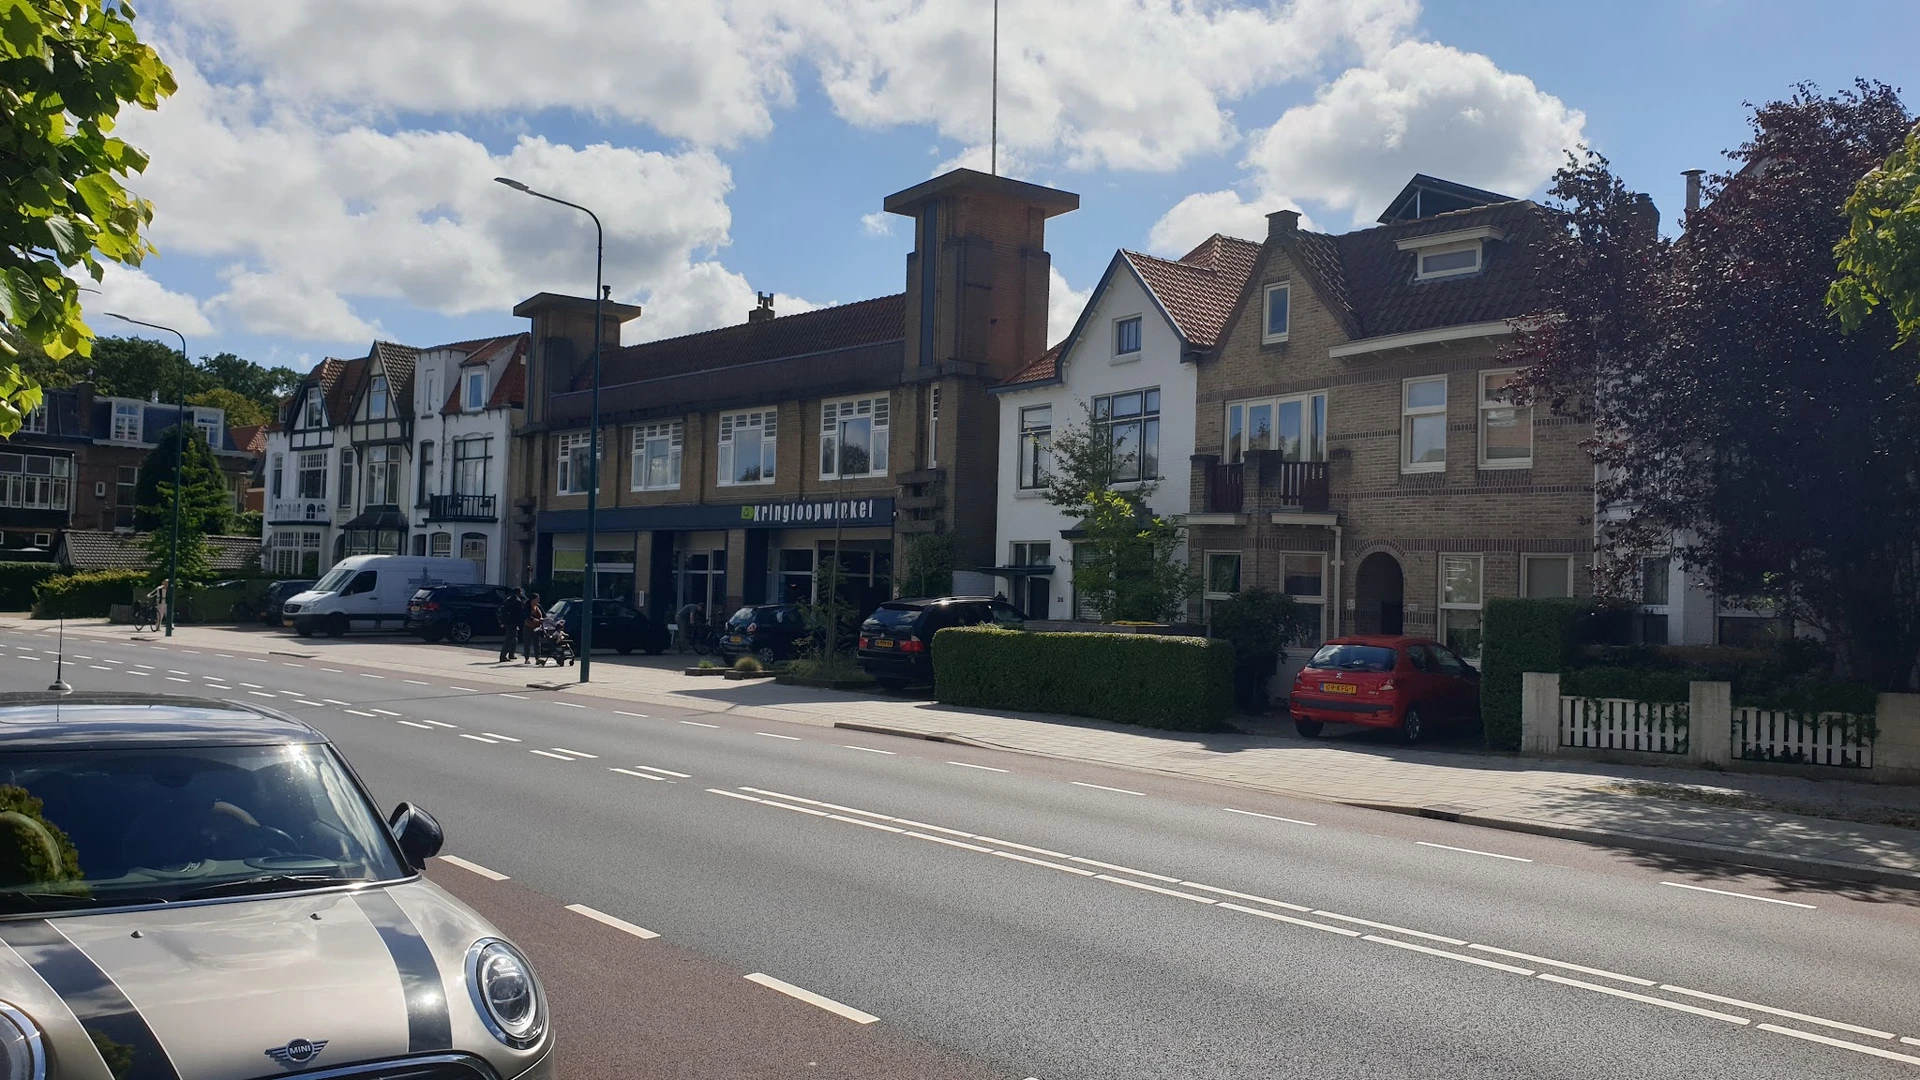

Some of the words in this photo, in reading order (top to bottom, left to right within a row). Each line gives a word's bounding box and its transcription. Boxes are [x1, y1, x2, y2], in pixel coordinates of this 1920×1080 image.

[753, 499, 873, 523] Kringloopwinkel
[1325, 684, 1354, 693] 09-KFG-1
[289, 1044, 311, 1055] MINI
